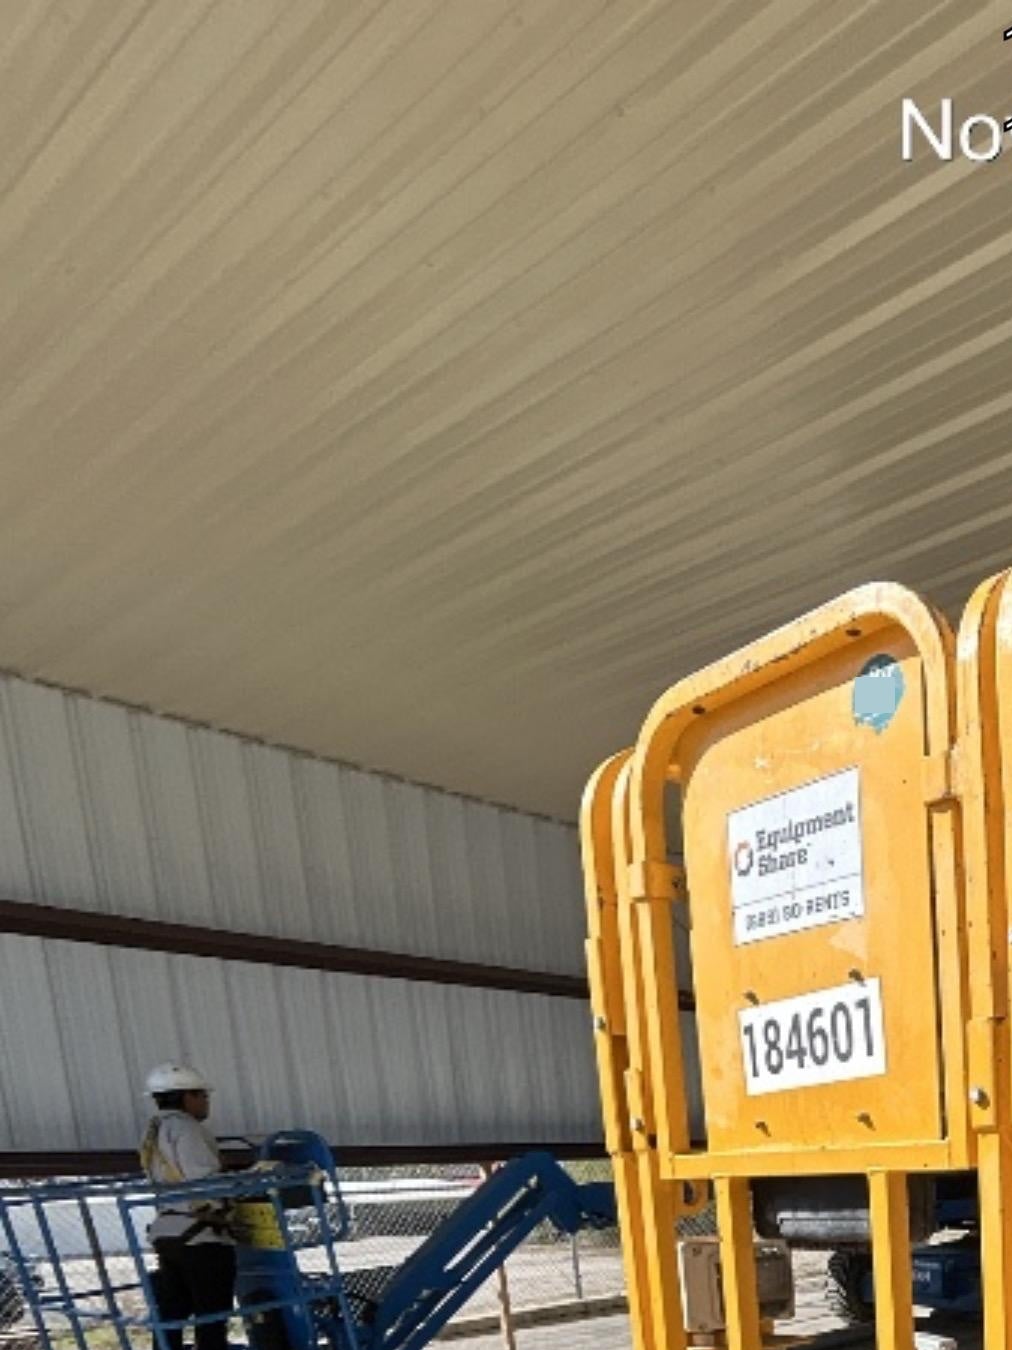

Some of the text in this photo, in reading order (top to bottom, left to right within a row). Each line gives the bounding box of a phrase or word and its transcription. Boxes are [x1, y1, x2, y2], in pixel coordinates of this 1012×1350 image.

[755, 801, 855, 851] Equipment
[757, 848, 808, 877] Share
[743, 996, 874, 1078] 184601
